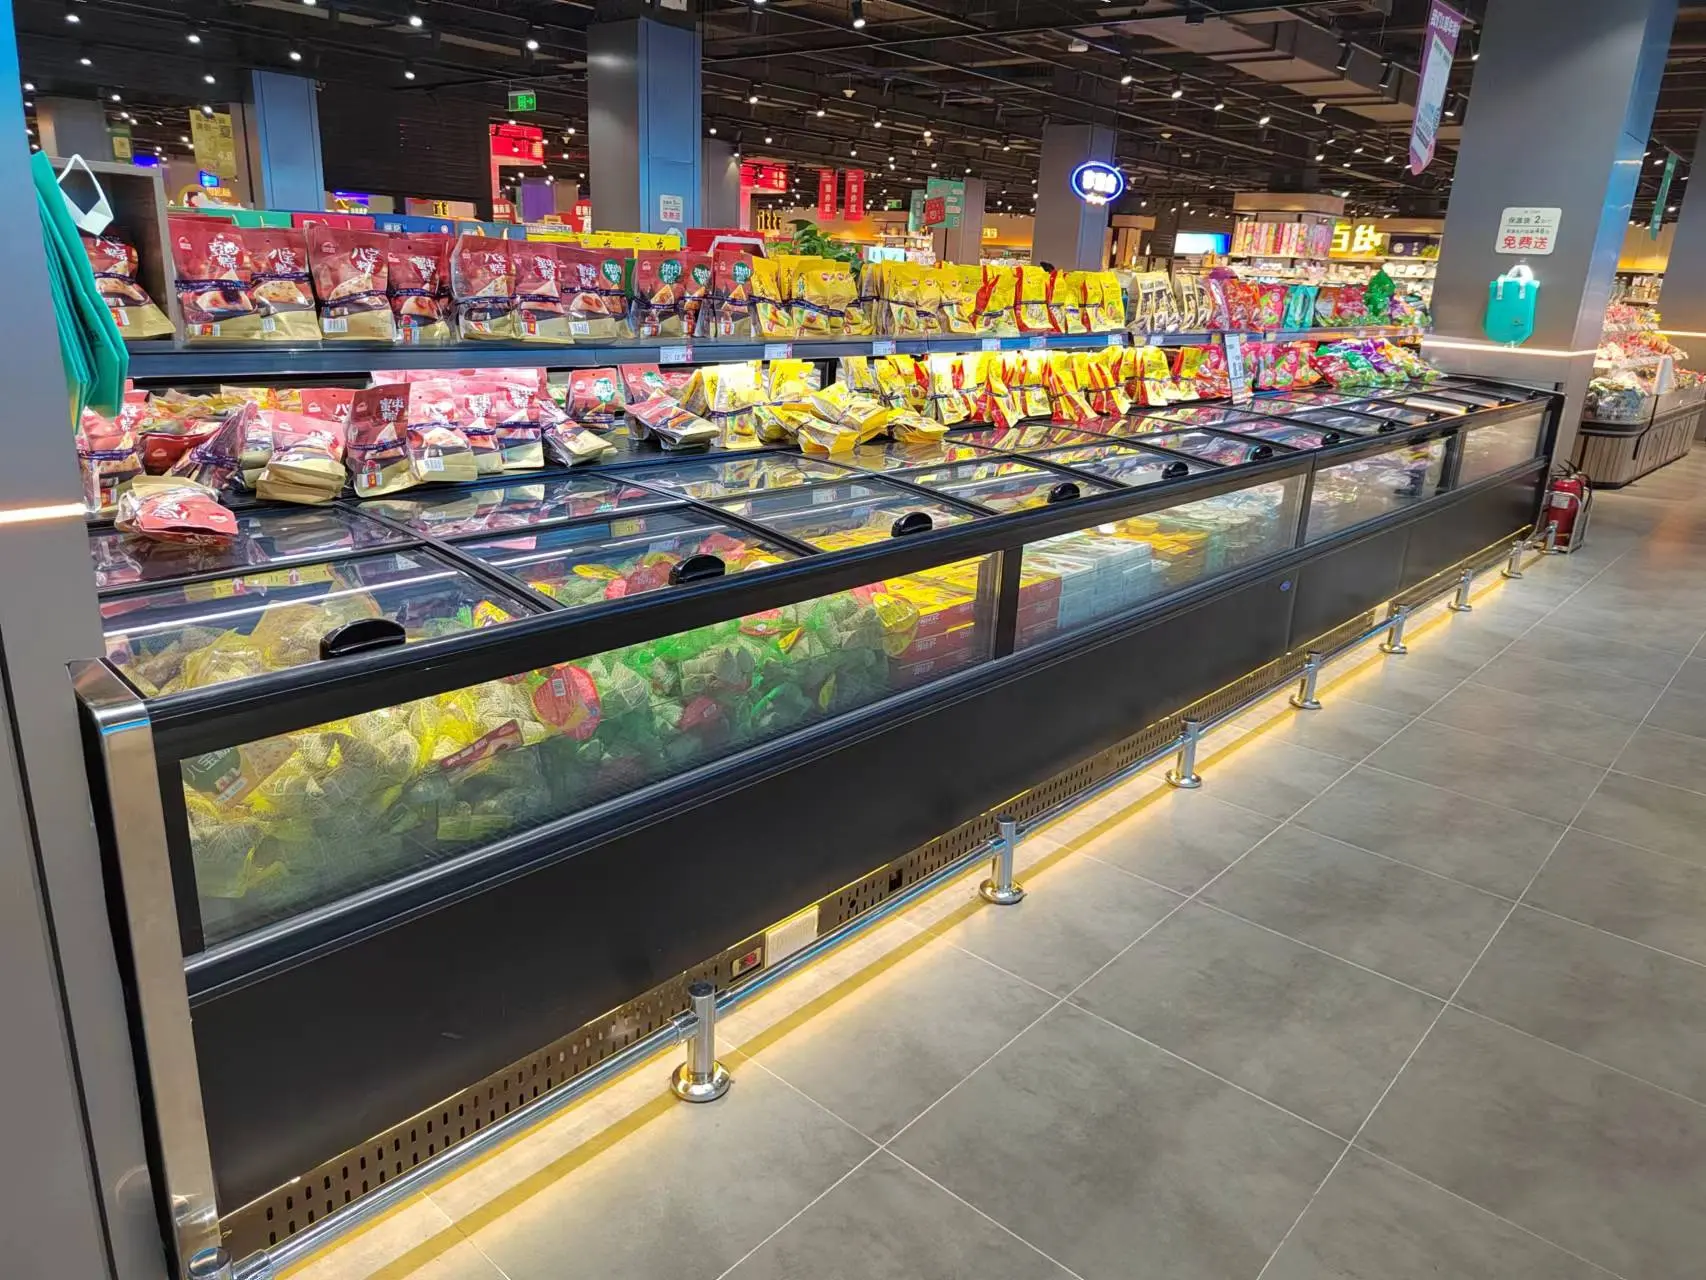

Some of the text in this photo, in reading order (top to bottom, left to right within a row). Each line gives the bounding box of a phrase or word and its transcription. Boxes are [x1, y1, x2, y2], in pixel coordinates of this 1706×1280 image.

[1502, 235, 1548, 249] 免费送
[352, 247, 380, 264] 八宝
